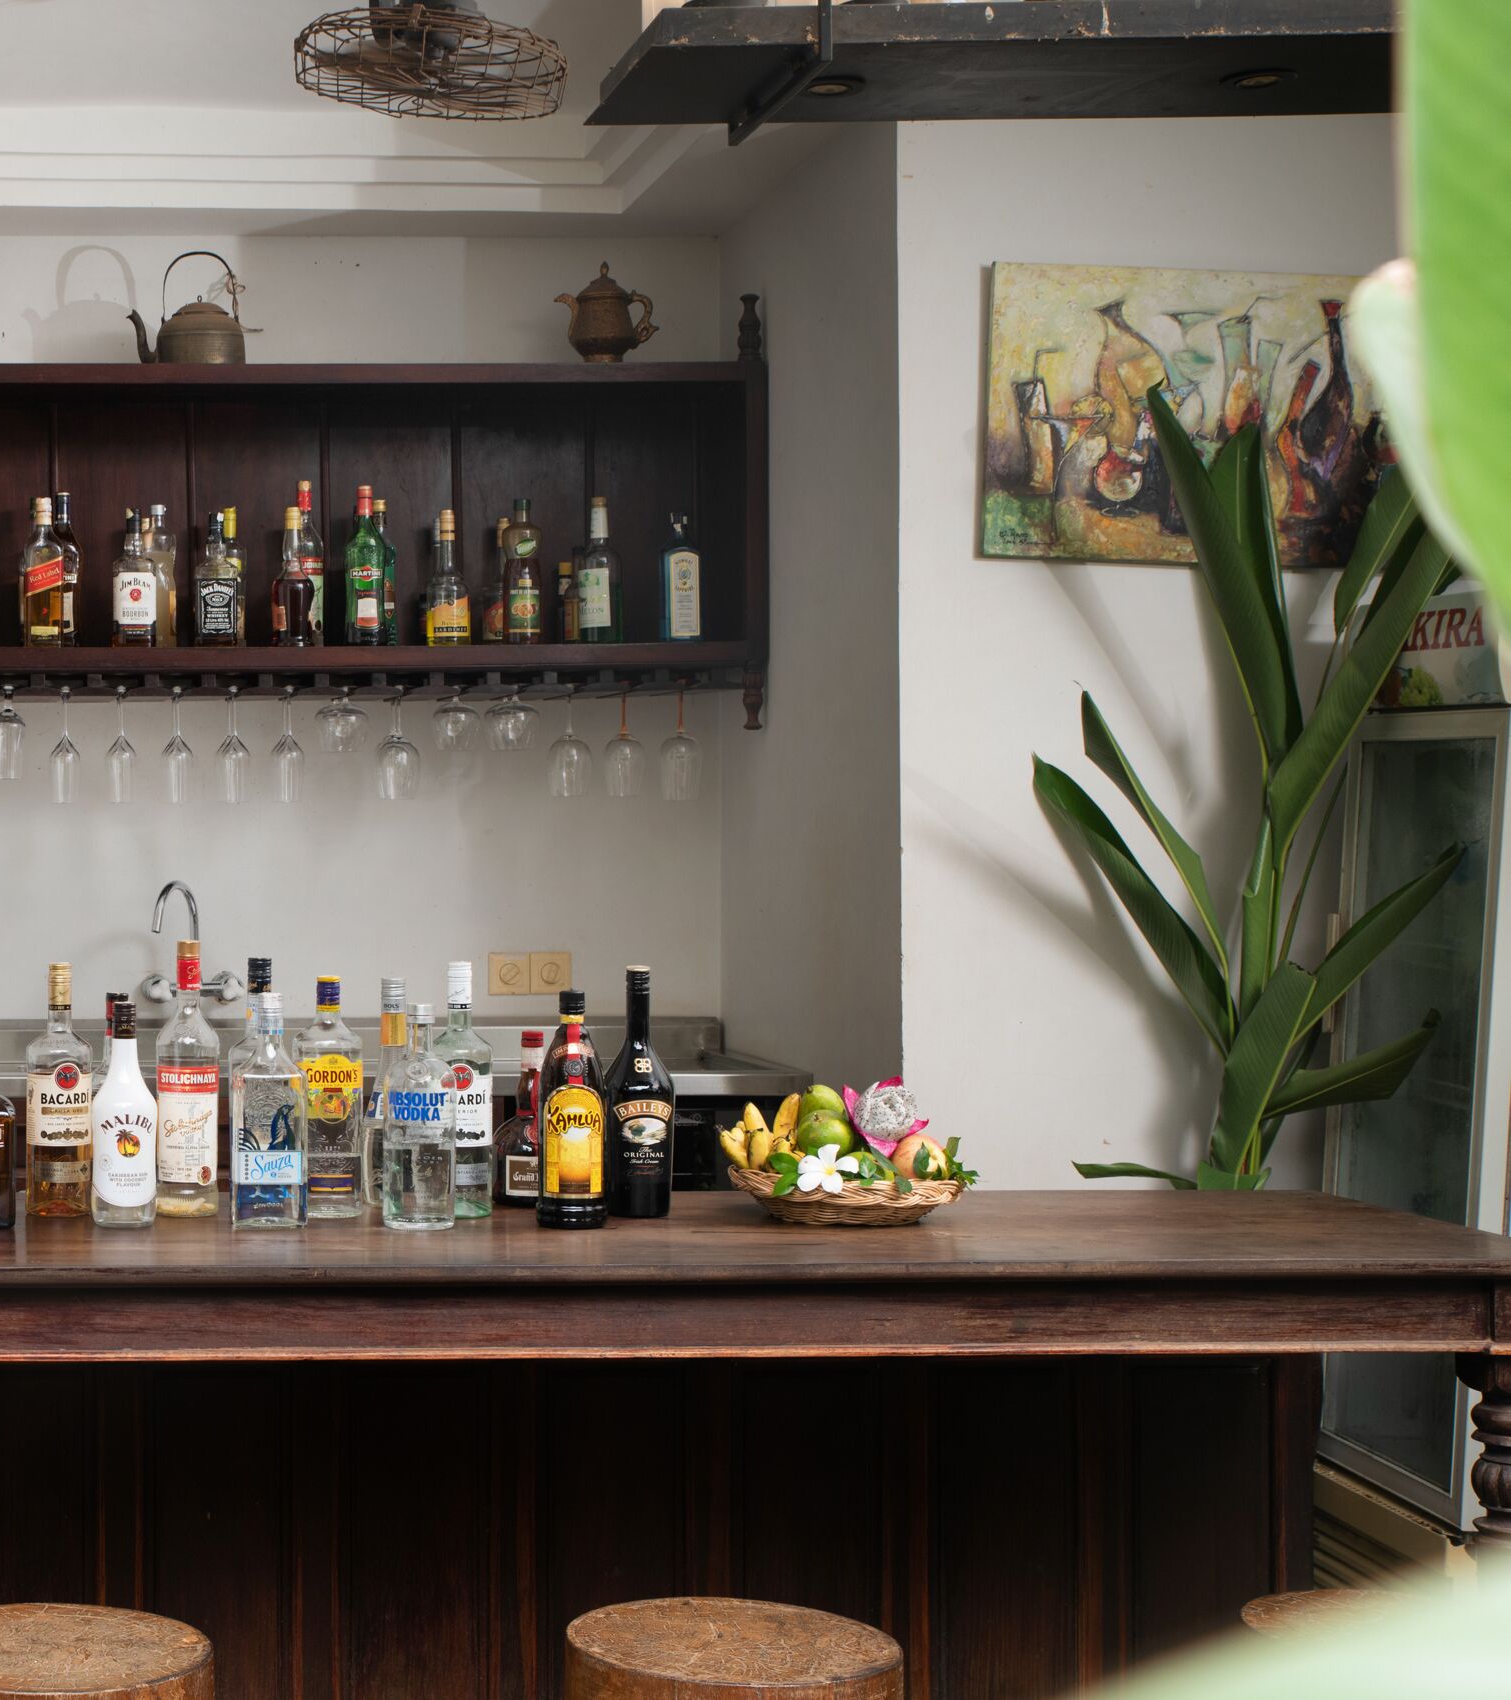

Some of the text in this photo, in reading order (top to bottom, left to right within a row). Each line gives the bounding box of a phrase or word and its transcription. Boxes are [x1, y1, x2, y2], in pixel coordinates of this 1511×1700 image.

[29, 573, 42, 583] Red
[42, 567, 60, 578] Label
[119, 578, 151, 591] JIM BEAM
[200, 585, 214, 597] JACK
[160, 1072, 216, 1085] STOLICHNAYA
[306, 1068, 358, 1083] GORDON'S
[389, 1091, 446, 1107] ABSOLUT
[458, 1089, 487, 1105] ARDÍ
[394, 1105, 441, 1121] VODKA
[618, 1103, 669, 1117] BAILEYS
[100, 1114, 154, 1135] MALIBU
[547, 1105, 602, 1134] KAHLÚA
[251, 1154, 294, 1181] Sauza
[512, 1171, 535, 1182] Grand
